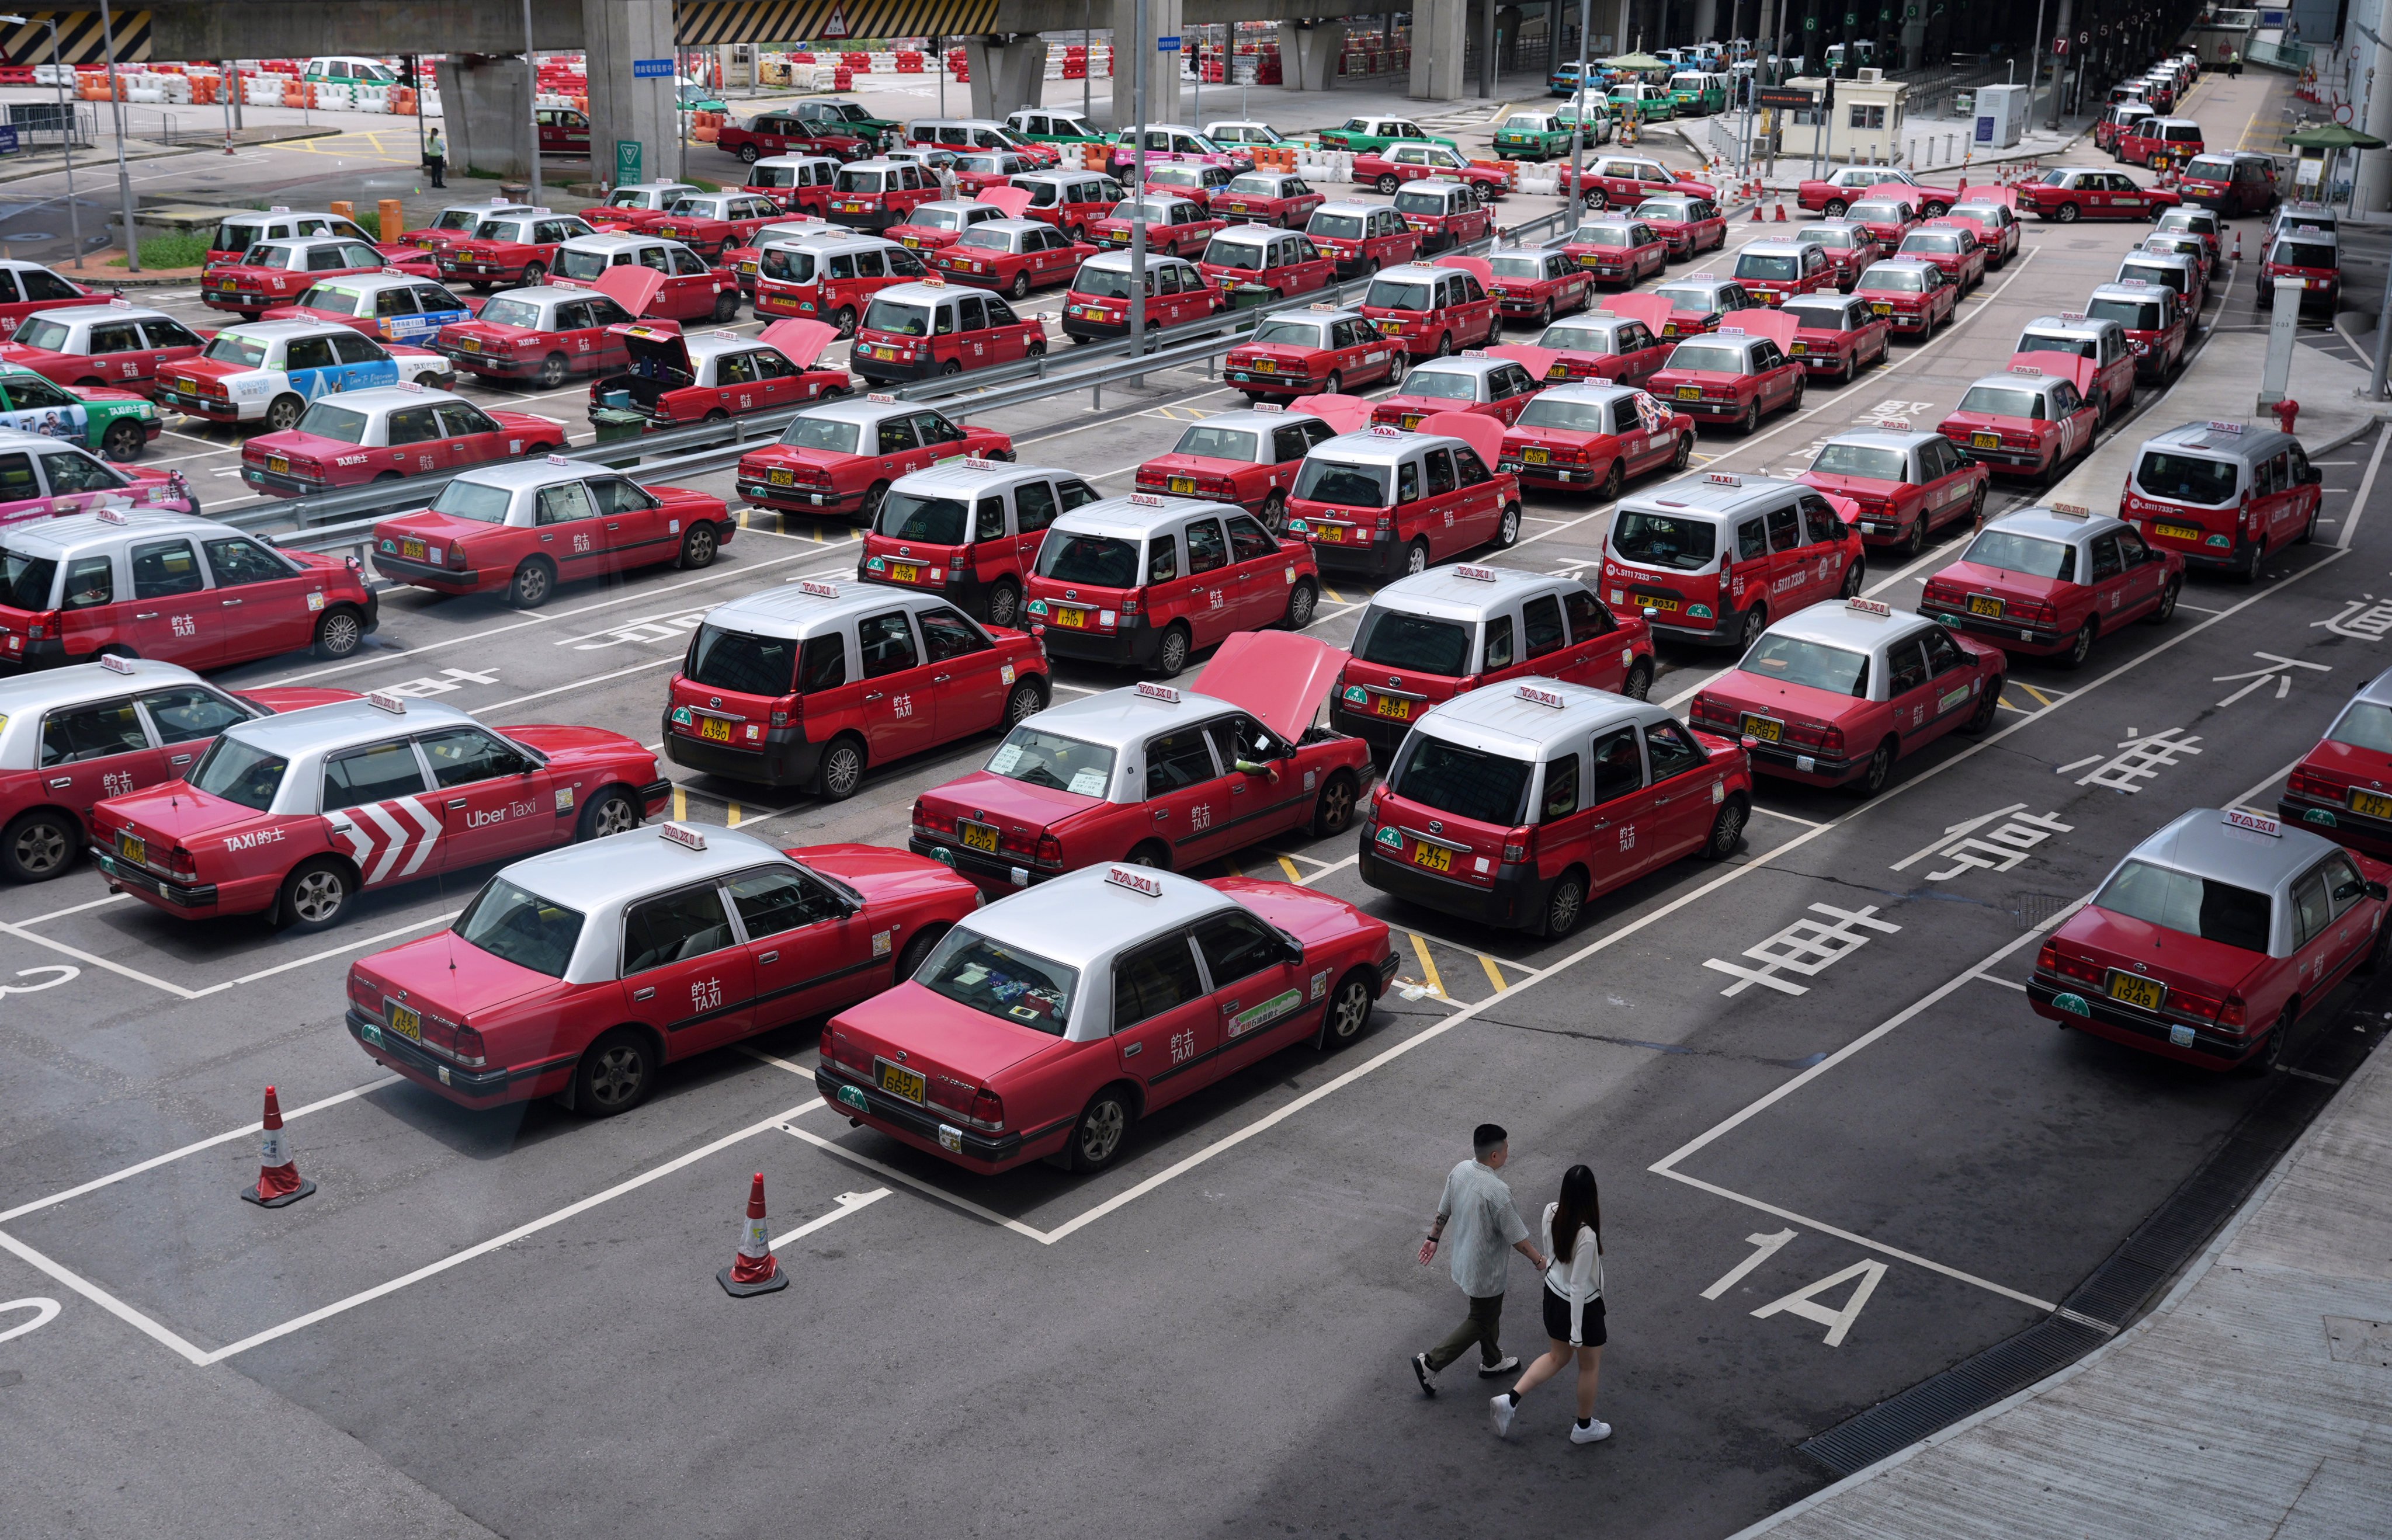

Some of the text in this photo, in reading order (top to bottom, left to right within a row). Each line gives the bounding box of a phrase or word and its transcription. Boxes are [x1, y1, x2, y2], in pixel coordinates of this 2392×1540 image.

[1881, 10, 1888, 19] 4
[1910, 7, 1916, 16] 3
[2144, 12, 2150, 22] 2
[1806, 18, 1814, 31] 6
[1847, 14, 1854, 25] 5
[2116, 20, 2124, 31] 4
[2131, 15, 2138, 25] 3
[2079, 32, 2088, 44] 6
[2057, 40, 2066, 53] 7
[554, 281, 572, 290] TAXI
[414, 362, 426, 370] TAXI
[740, 393, 751, 401] 的士
[741, 400, 752, 408] TAXI
[108, 406, 124, 415] TAXI
[1883, 420, 1908, 429] TAXI
[2211, 421, 2239, 431] TAXI
[1373, 428, 1395, 437] TAXI
[1977, 441, 1994, 449] 1705
[336, 454, 368, 467] TAXI 的士
[966, 459, 990, 468] TAXI
[1527, 454, 1544, 463] 9018
[777, 470, 787, 478] SD
[1711, 474, 1733, 484] TAXI
[773, 476, 789, 485] 3430
[1176, 484, 1188, 492] 1113
[1131, 494, 1158, 506] TAXI
[1444, 509, 1453, 519] 的士
[2056, 503, 2085, 515] TAXI
[2157, 505, 2173, 513] 7333
[1445, 517, 1454, 528] TAXI
[574, 533, 589, 543] 的士
[1318, 530, 1339, 541] 9380
[2158, 526, 2196, 538] ES 7776
[408, 541, 418, 550] KE
[574, 542, 589, 552] TAXI
[406, 548, 423, 558] 3252
[900, 564, 909, 572] LS
[1458, 566, 1489, 579] TAXI
[895, 571, 912, 580] 7198
[1620, 569, 1650, 580] 5111 7333
[1733, 575, 1743, 586] 的士
[1779, 571, 1805, 592] 5111 7333
[803, 583, 830, 595] TAXI
[1210, 589, 1222, 600] 的士
[1733, 585, 1744, 596] TAXI
[1211, 598, 1223, 610] TAXI
[1637, 596, 1675, 611] WP 8034
[1852, 597, 1885, 613] TAXI
[1982, 597, 1996, 606] RZ
[1067, 608, 1077, 617] YR
[1976, 604, 1997, 617] 7931
[171, 614, 193, 626] 的士
[1061, 615, 1078, 625] 1710
[173, 624, 195, 637] TAXI
[103, 655, 125, 672] TAXI
[1138, 684, 1172, 698] TAXI
[1521, 686, 1556, 704] TAXI
[371, 693, 396, 709] TAXI
[893, 693, 911, 707] 的士
[1348, 694, 1364, 704] SEATS
[1388, 696, 1402, 705] WW
[894, 704, 912, 719] TAXI
[1380, 704, 1405, 717] 5893
[712, 720, 722, 729] YN
[1756, 717, 1771, 728] SH
[703, 727, 726, 740] 6390
[1748, 724, 1777, 741] 8087
[104, 771, 131, 787] 的士
[106, 783, 133, 795] TAXI
[467, 798, 536, 829] Uber Taxi
[1192, 803, 1210, 819] 的士
[2360, 803, 2386, 818] 447
[1192, 815, 1210, 831] TAXI
[2230, 812, 2275, 833] TAXI
[664, 825, 695, 845] TAXI
[975, 826, 990, 837] VM
[1385, 826, 1398, 836] TAXI
[1387, 832, 1394, 840] 4
[1620, 823, 1635, 839] 的士
[224, 828, 285, 851] TAXI 的士
[970, 835, 992, 851] 2212
[1380, 837, 1398, 847] SEATS
[1620, 836, 1635, 853] TAXI
[1427, 845, 1440, 856] WZ
[1419, 853, 1448, 868] 2737
[1112, 869, 1151, 891] TAXI
[692, 977, 720, 996] 的士
[2128, 978, 2146, 992] UA
[692, 990, 721, 1012] TAXI
[2117, 988, 2151, 1006] 1948
[2059, 1003, 2084, 1015] SEATS
[2070, 999, 2076, 1009] 4
[394, 1019, 418, 1039] 4520
[1171, 1028, 1193, 1049] 的士
[1171, 1042, 1193, 1063] TAXI
[886, 1077, 919, 1100] 6624
[950, 1077, 976, 1091] COMFORT
[847, 1086, 861, 1096] TAXI
[849, 1092, 855, 1101] 4
[841, 1097, 864, 1110] SEATS
[1699, 1228, 1889, 1347] 1A
